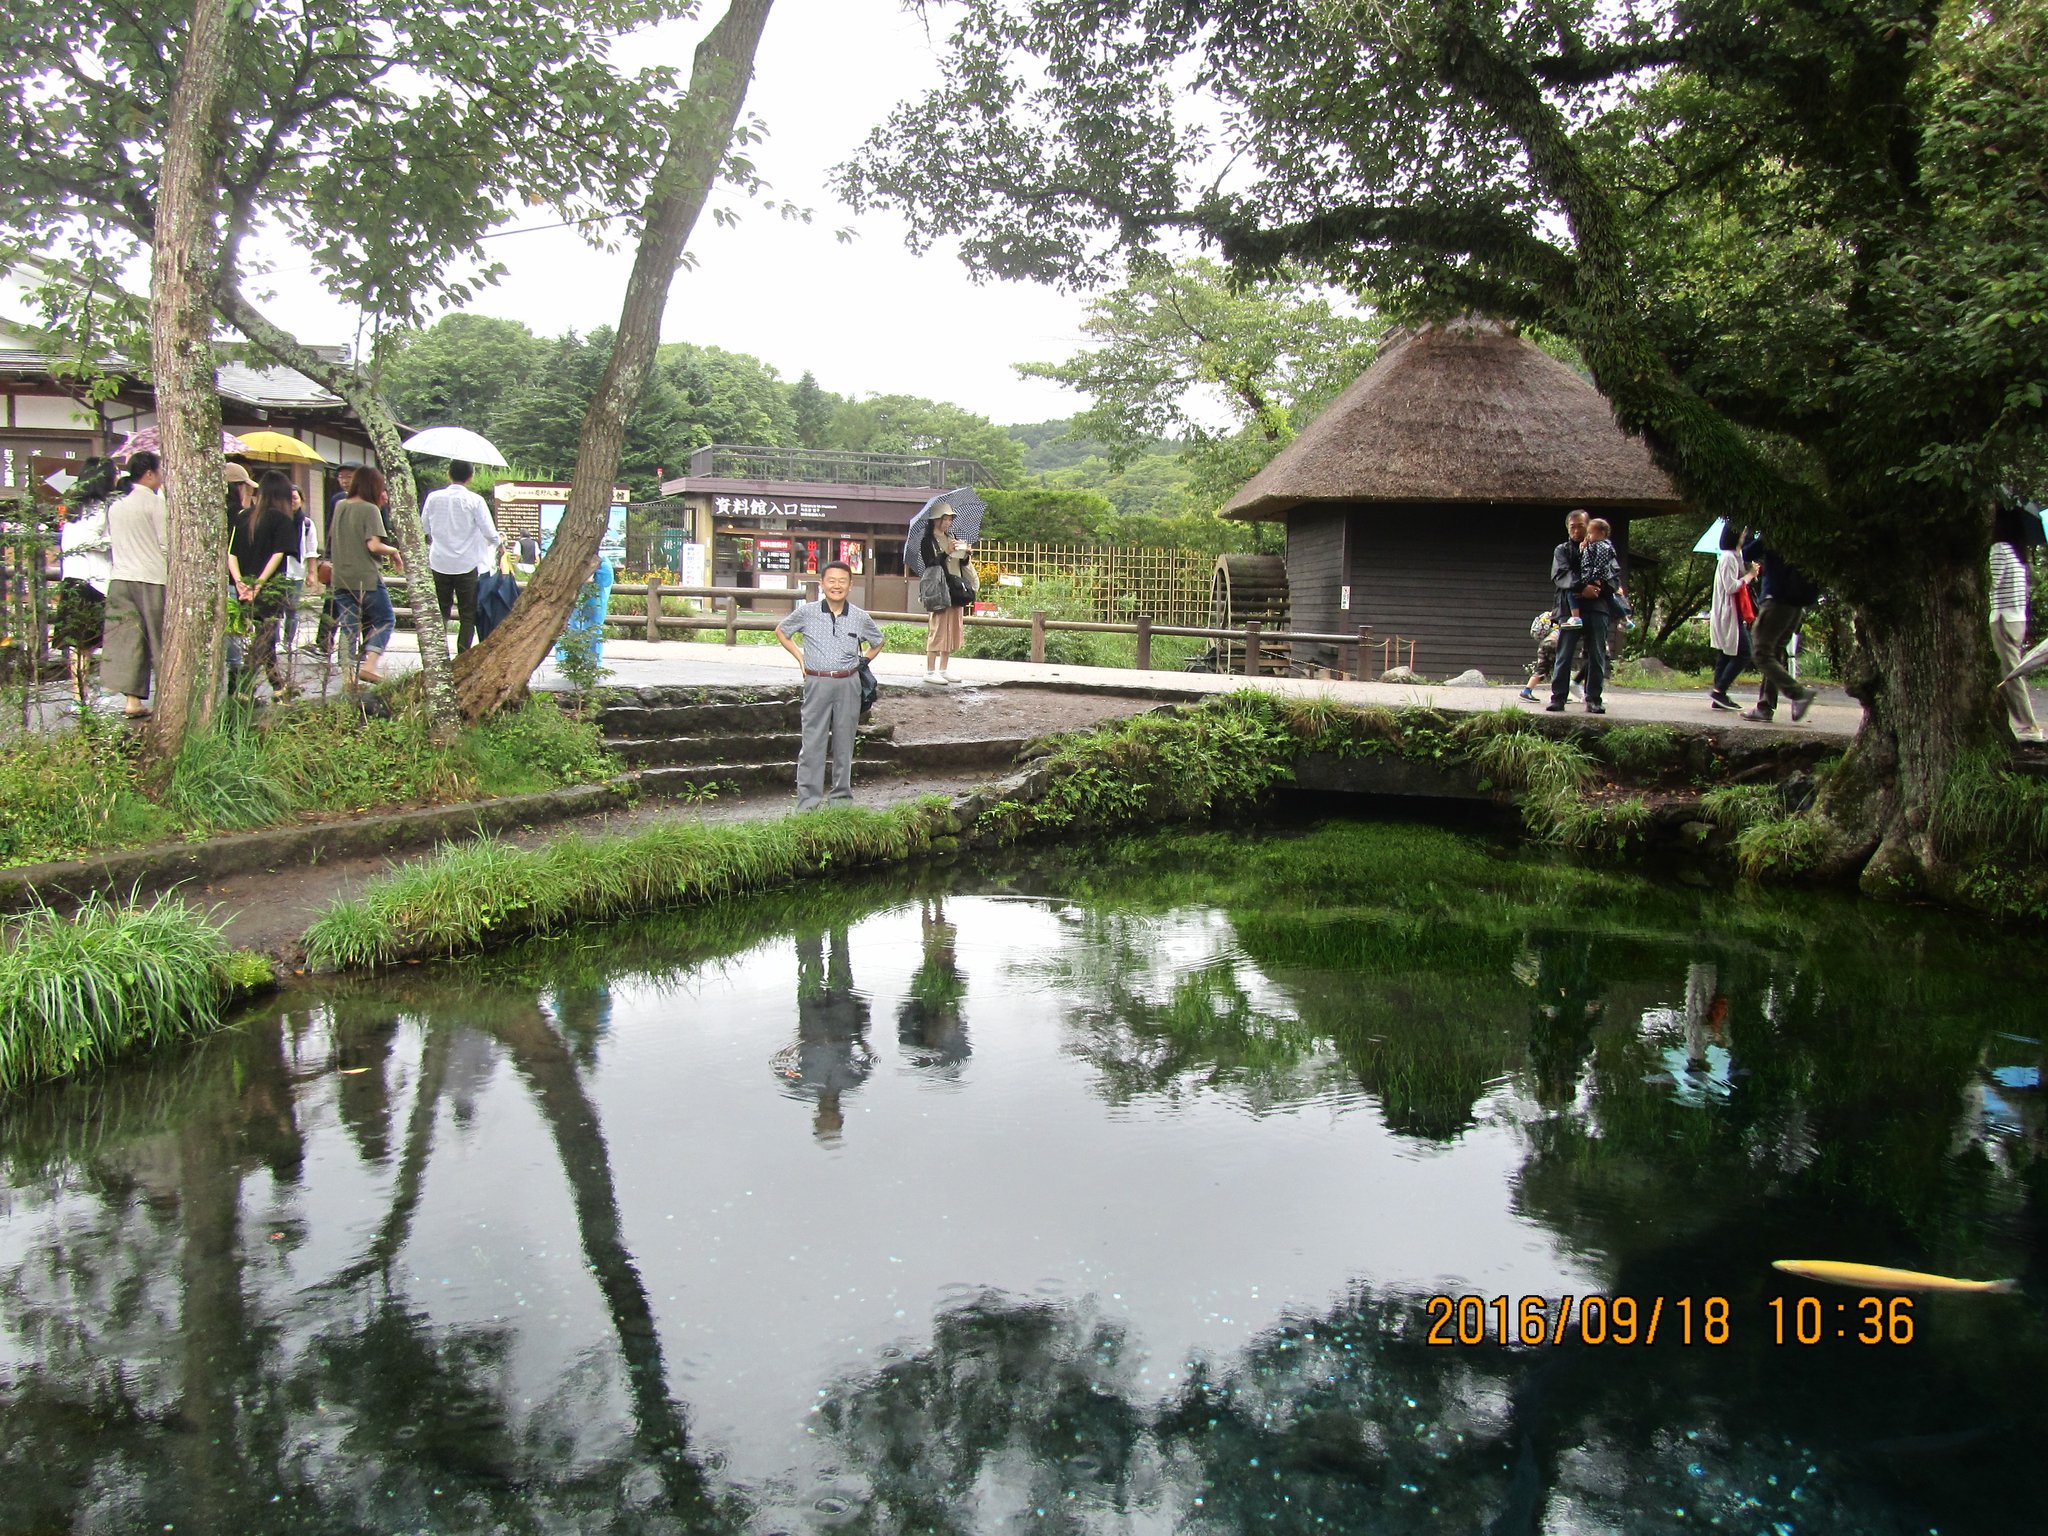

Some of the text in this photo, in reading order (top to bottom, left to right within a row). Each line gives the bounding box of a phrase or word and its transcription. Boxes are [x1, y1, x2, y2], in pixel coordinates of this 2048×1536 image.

[715, 497, 798, 515] 資料館入口
[807, 540, 817, 570] 出入口
